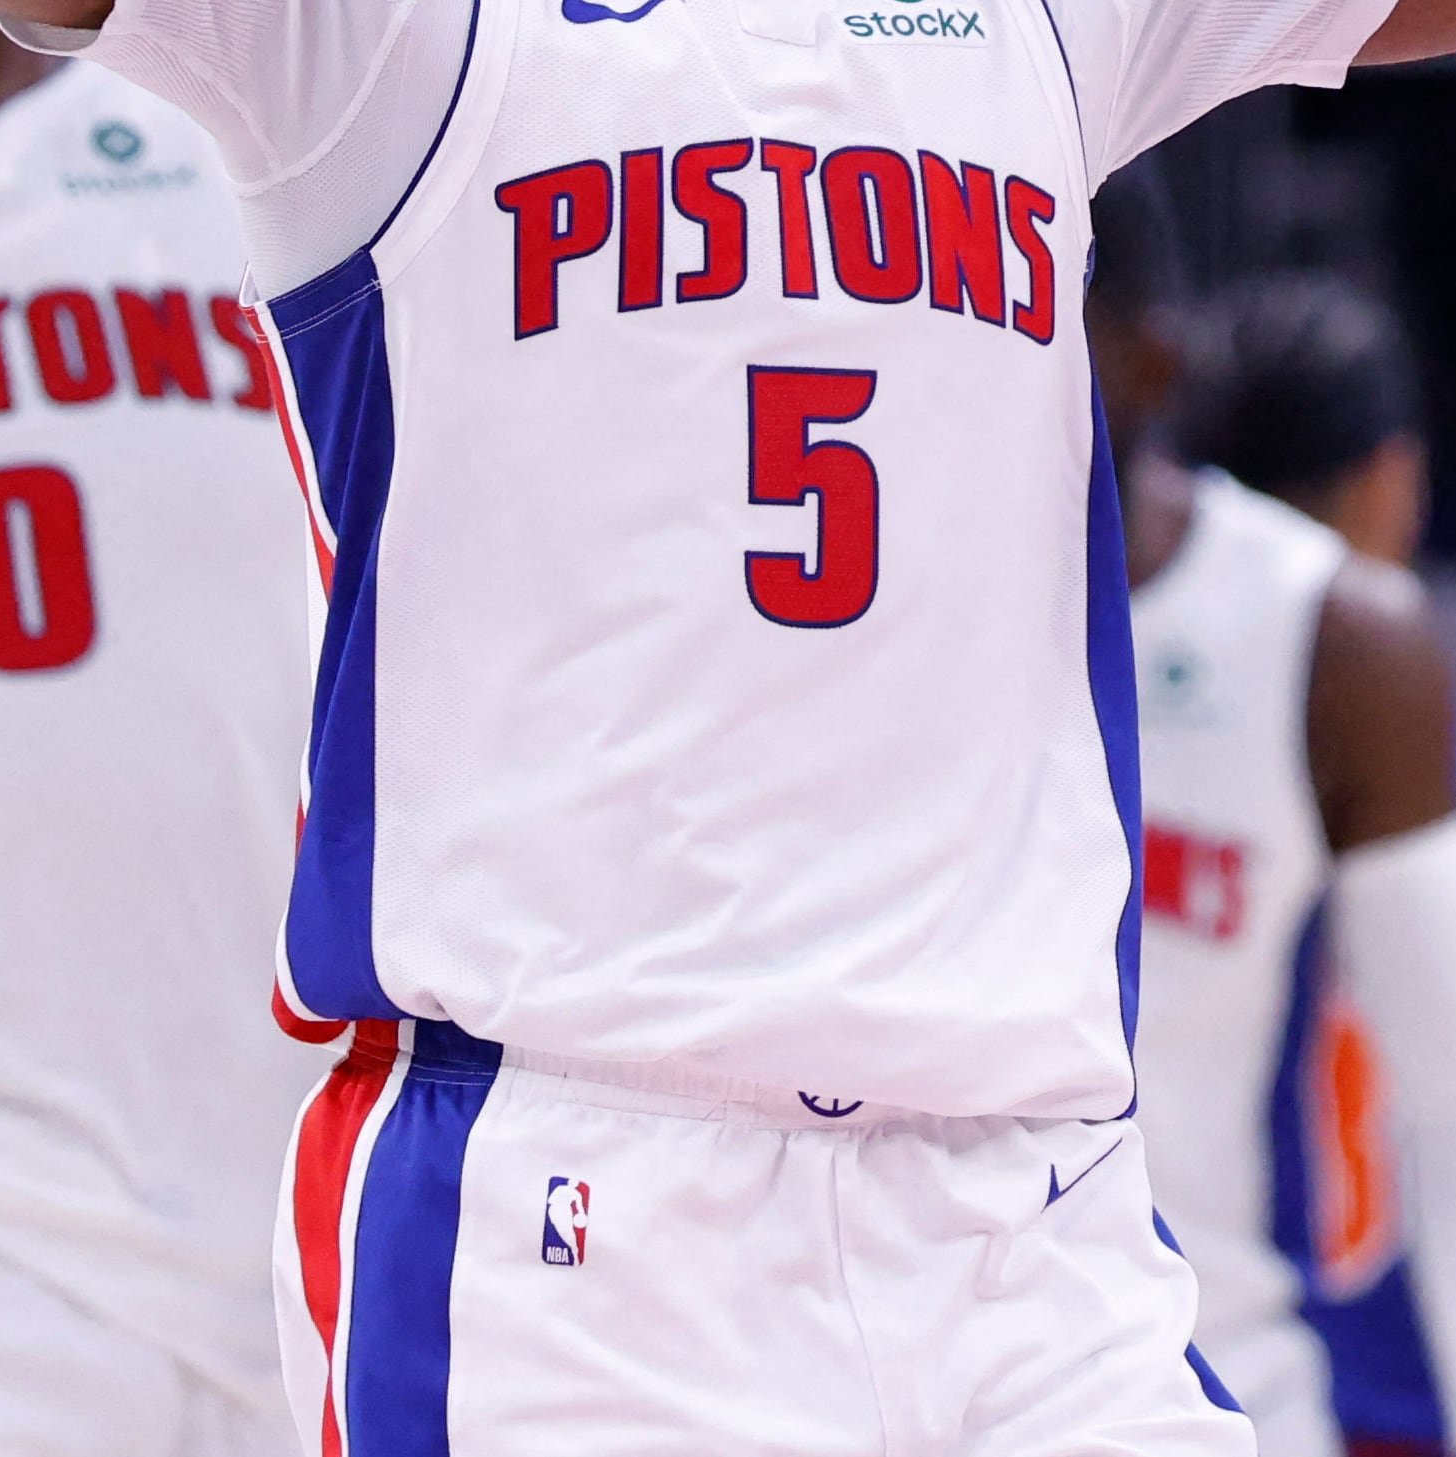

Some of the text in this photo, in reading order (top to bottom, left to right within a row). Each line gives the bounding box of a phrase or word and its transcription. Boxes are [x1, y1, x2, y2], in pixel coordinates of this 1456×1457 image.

[494, 136, 1056, 346] PISTONS
[744, 363, 879, 630] 5
[546, 1245, 570, 1264] NBA
